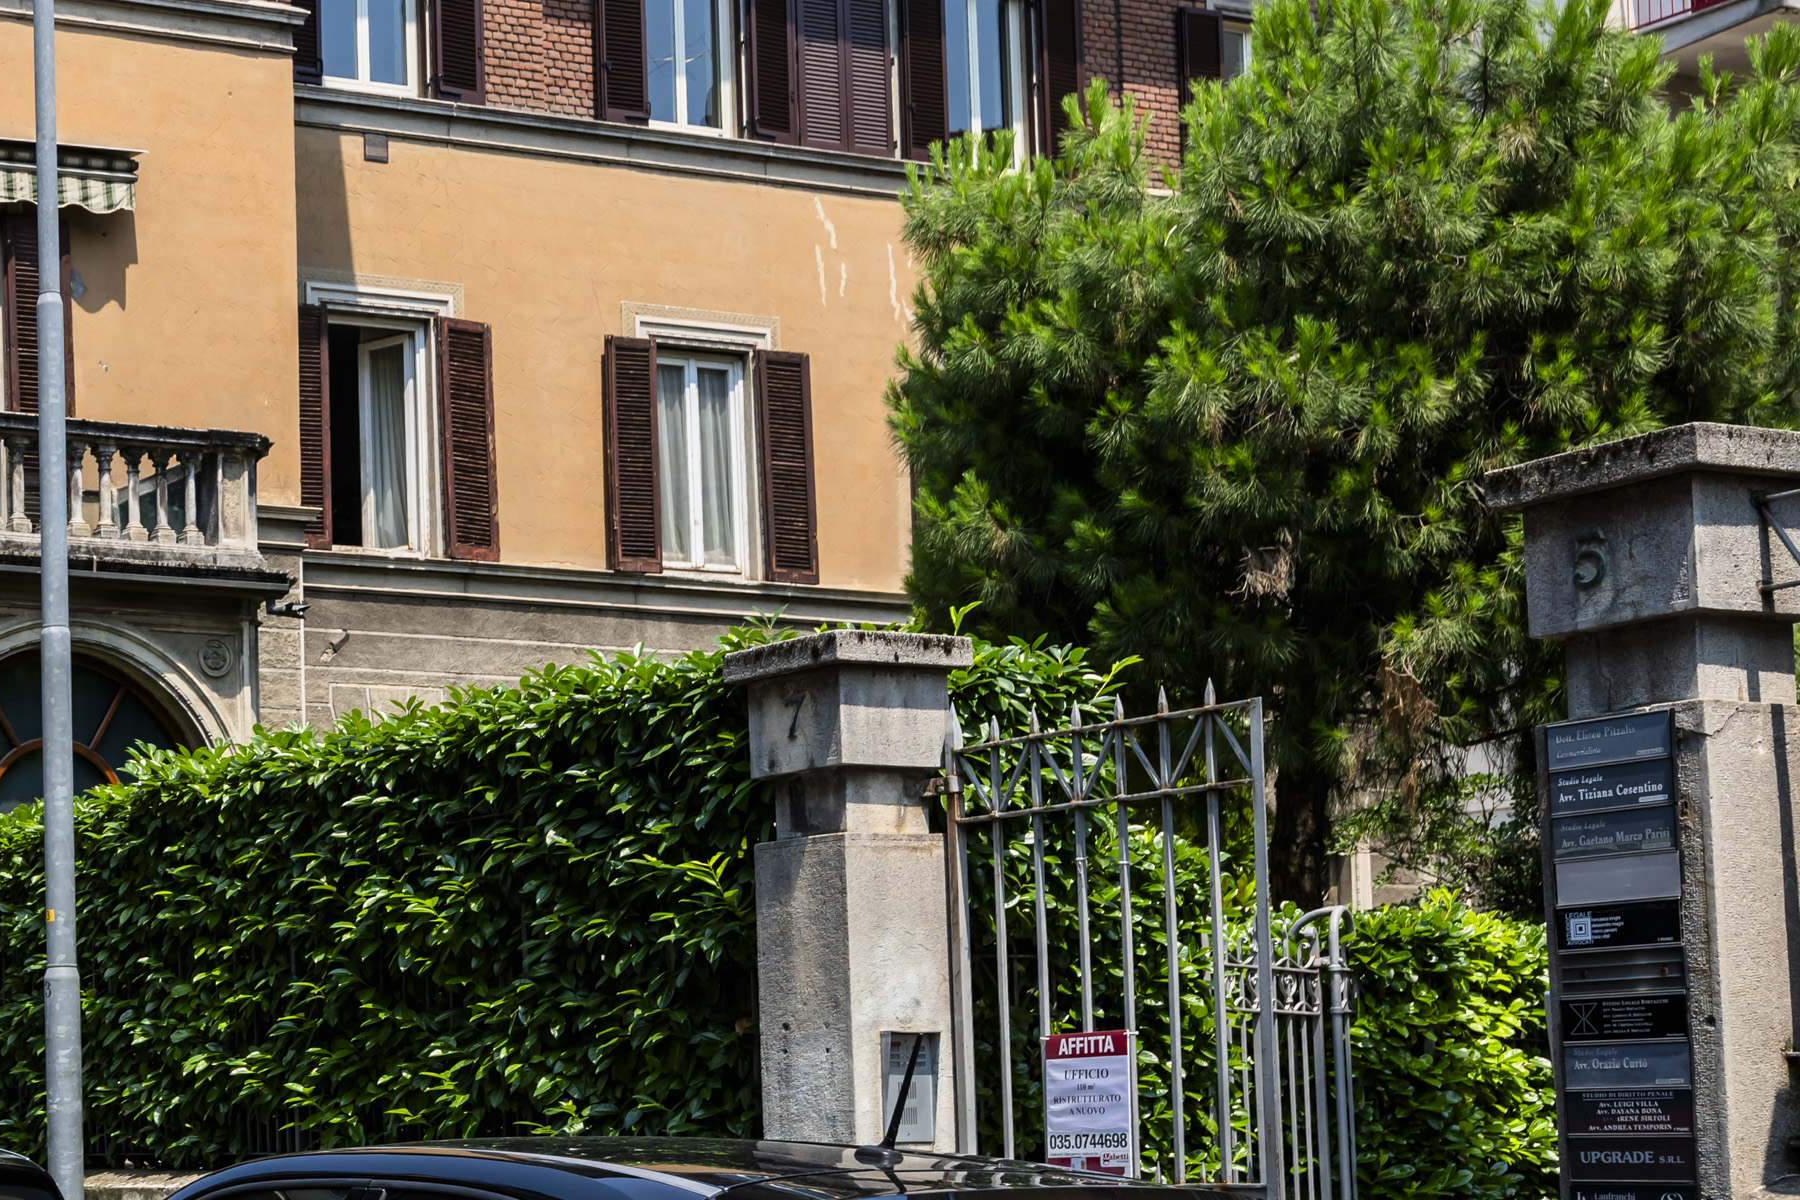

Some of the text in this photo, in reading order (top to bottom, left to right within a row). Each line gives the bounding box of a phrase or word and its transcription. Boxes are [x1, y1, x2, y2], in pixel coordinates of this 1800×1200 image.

[1573, 529, 1606, 588] 5
[781, 694, 806, 738] 7
[1577, 730, 1601, 741] Eliseo
[1604, 723, 1635, 737] Pitzalis
[1558, 774, 1603, 787] Studio Legale
[1559, 781, 1663, 803] Avv. Tiziana Cosentino
[1562, 827, 1670, 848] Avv. Gaetano Marco Parisi
[1565, 911, 1592, 920] LEGALE
[1058, 1035, 1115, 1056] AFFITTA
[1574, 1061, 1590, 1070] Avv.
[1592, 1058, 1620, 1069] Orazio
[1064, 1068, 1109, 1080] UFFICIO
[1053, 1094, 1121, 1104] RISTRUTTURATO
[1069, 1106, 1106, 1116] A NUOVO
[1050, 1133, 1128, 1149] 035.0744698
[1103, 1153, 1129, 1165] gabetti
[1580, 1151, 1685, 1164] UPGRADE S.R.L.
